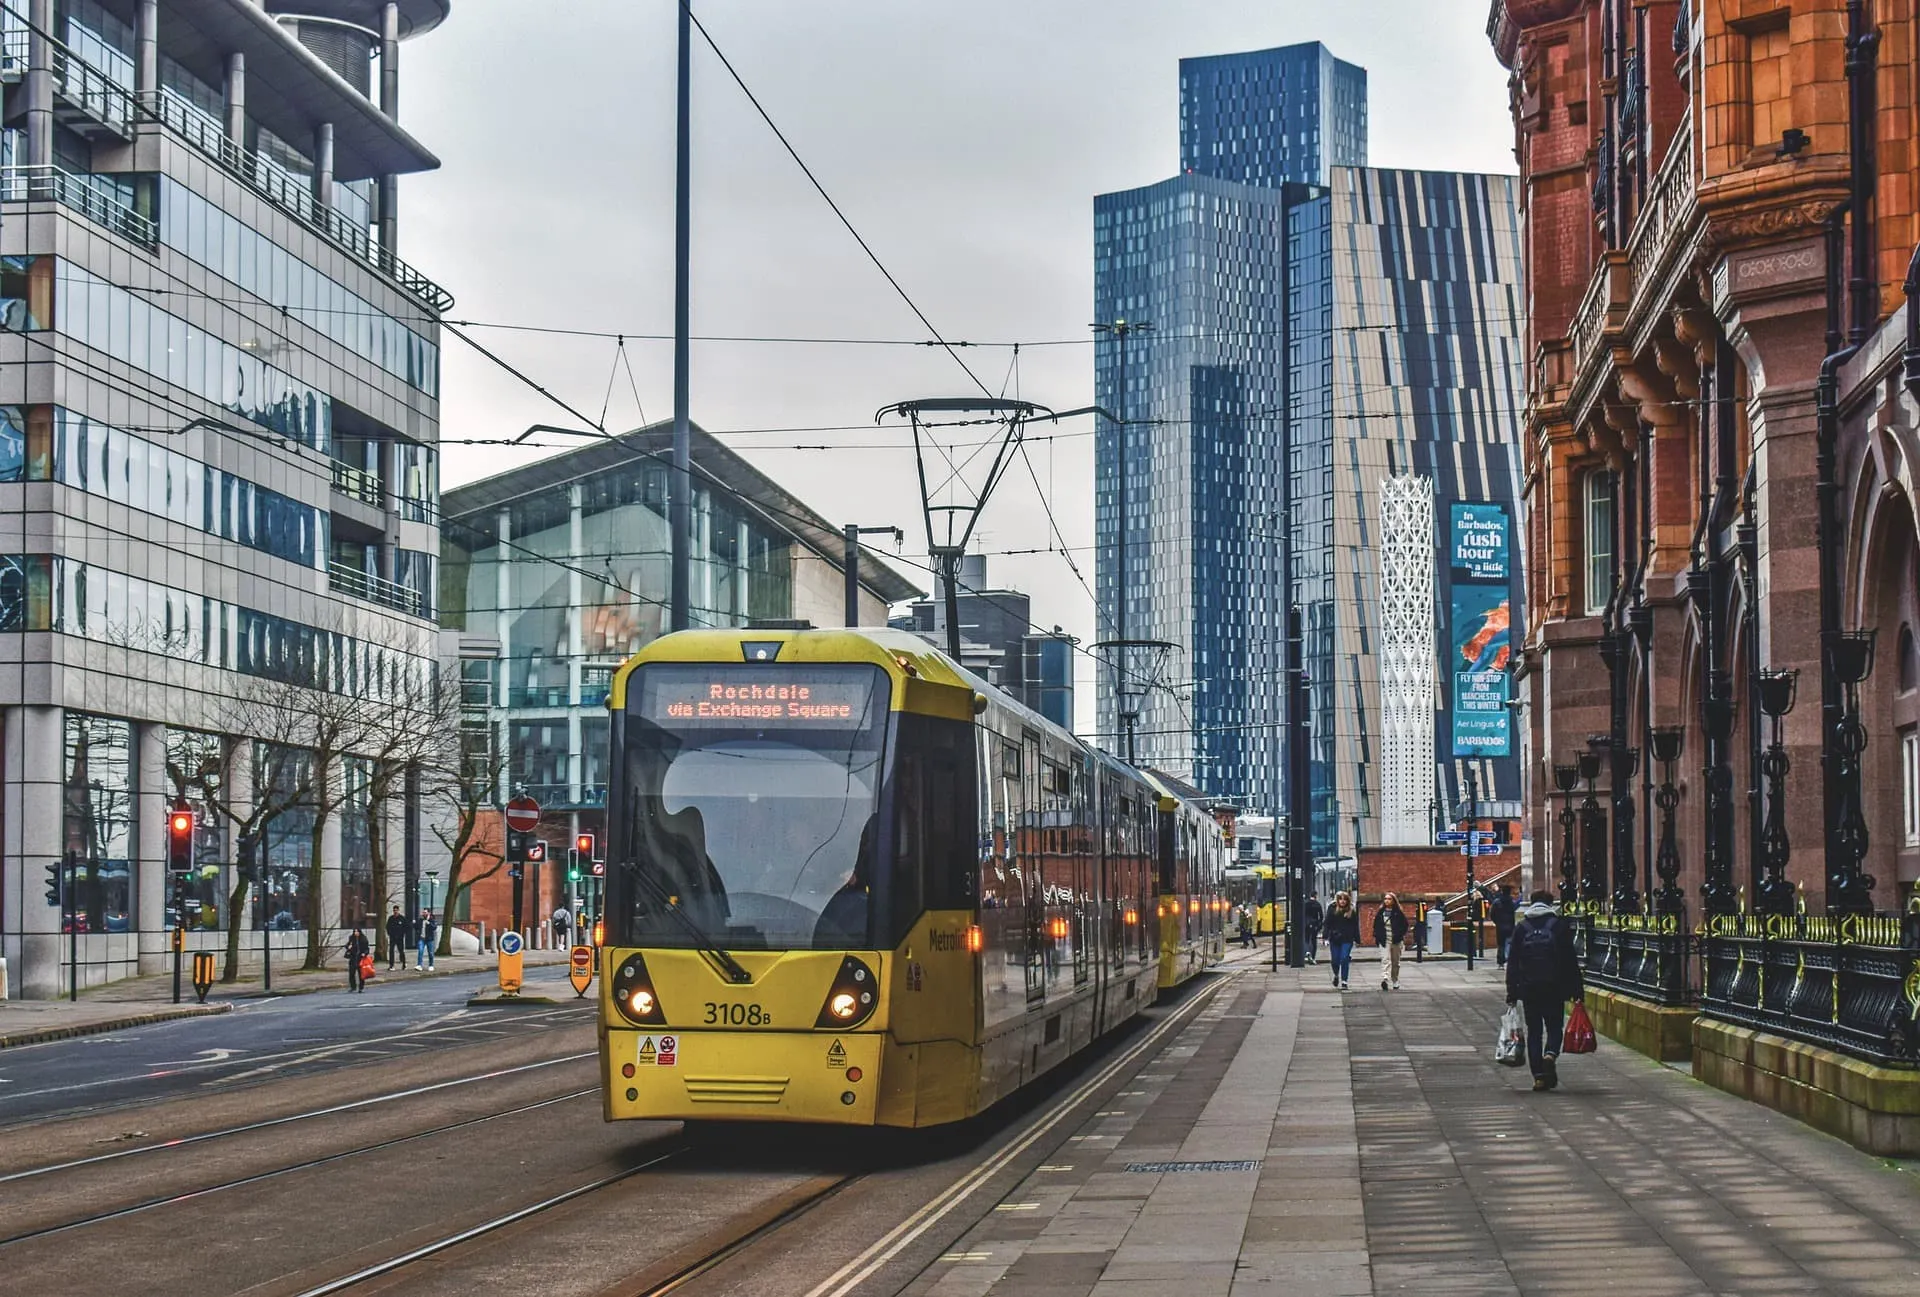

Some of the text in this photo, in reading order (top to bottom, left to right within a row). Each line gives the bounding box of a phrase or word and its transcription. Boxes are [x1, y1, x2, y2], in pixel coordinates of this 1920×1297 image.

[1463, 511, 1474, 520] In
[1463, 530, 1502, 547] rush
[1457, 544, 1495, 559] hour
[1474, 563, 1481, 571] a
[1482, 561, 1503, 572] little
[1460, 674, 1471, 683] FLY
[709, 684, 810, 700] Rochdale
[1472, 683, 1490, 692] FROM
[1461, 692, 1501, 701] MANCHESTER
[667, 702, 851, 718] via Exchange Square
[1462, 701, 1500, 710] THIS WINTER
[1457, 720, 1495, 730] Aer Lingus
[1457, 736, 1505, 746] BARBADOS
